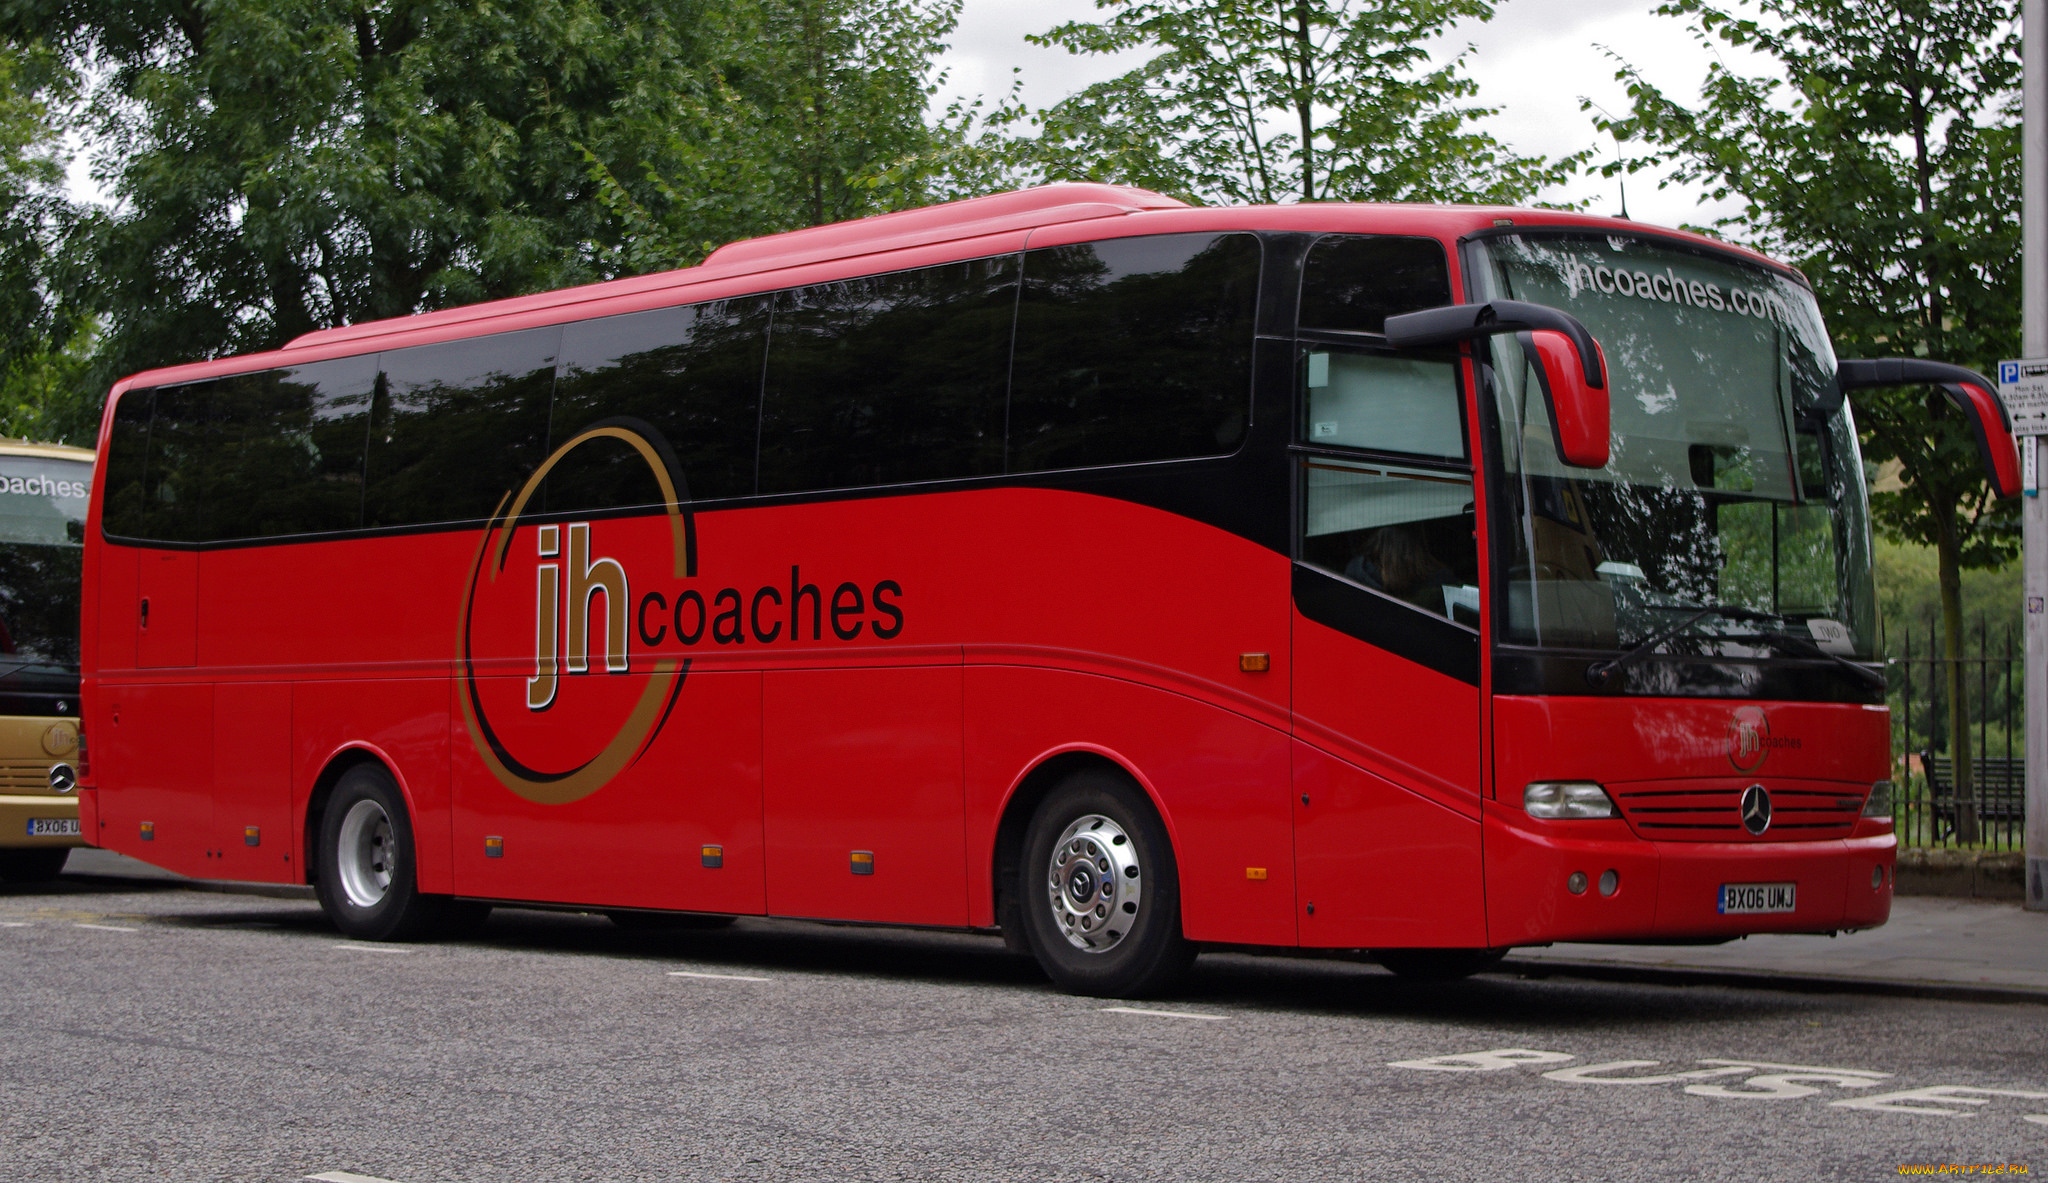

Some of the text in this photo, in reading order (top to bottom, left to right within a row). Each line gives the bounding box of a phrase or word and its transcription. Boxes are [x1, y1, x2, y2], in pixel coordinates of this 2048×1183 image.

[1560, 251, 1793, 324] jhcoaches.com
[2004, 365, 2017, 383] P
[527, 522, 904, 712] jh coaches
[1818, 625, 1841, 640] TWO
[1740, 722, 1802, 757] jh coaches
[37, 819, 68, 833] BX06
[1728, 887, 1794, 909] BX06 UMJ
